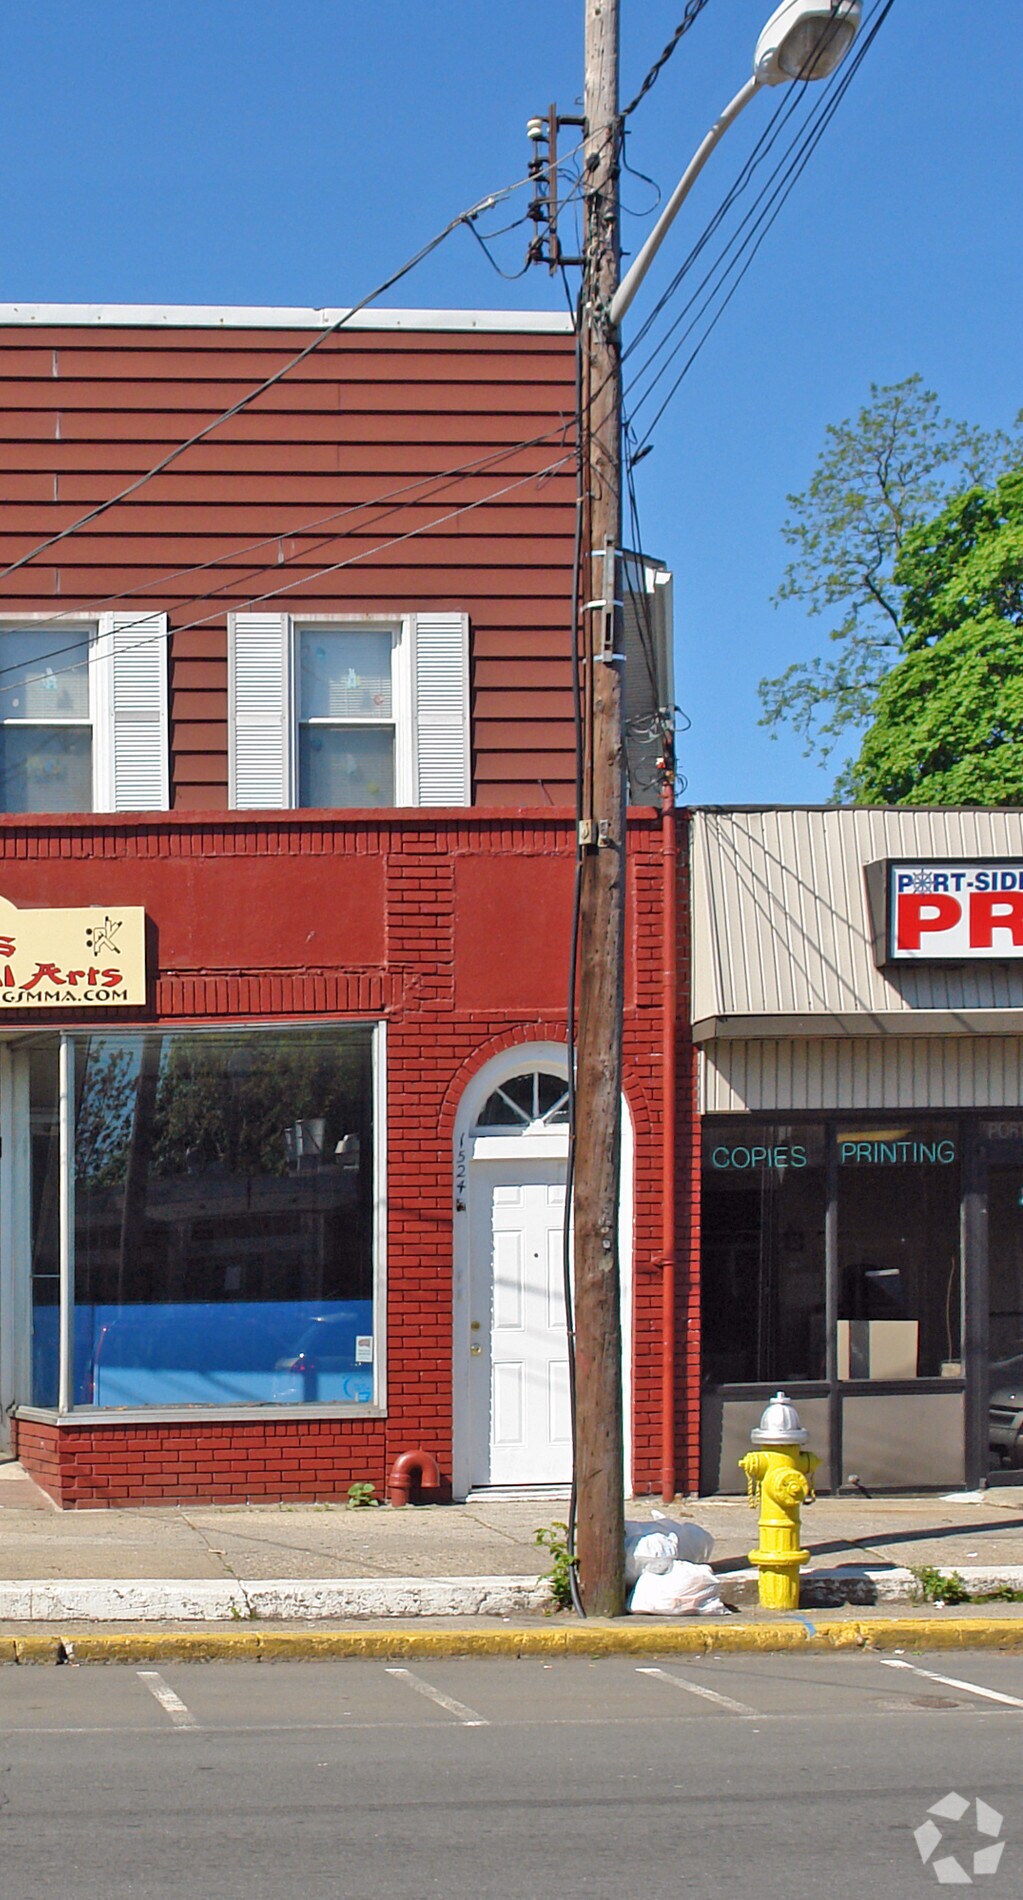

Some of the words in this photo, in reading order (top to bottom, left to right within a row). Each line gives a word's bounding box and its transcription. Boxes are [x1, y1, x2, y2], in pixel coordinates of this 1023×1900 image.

[898, 868, 1023, 895] PORT-SID
[19, 963, 124, 990] Arts
[712, 1146, 807, 1168] COPIES
[841, 1140, 955, 1164] PRINTING
